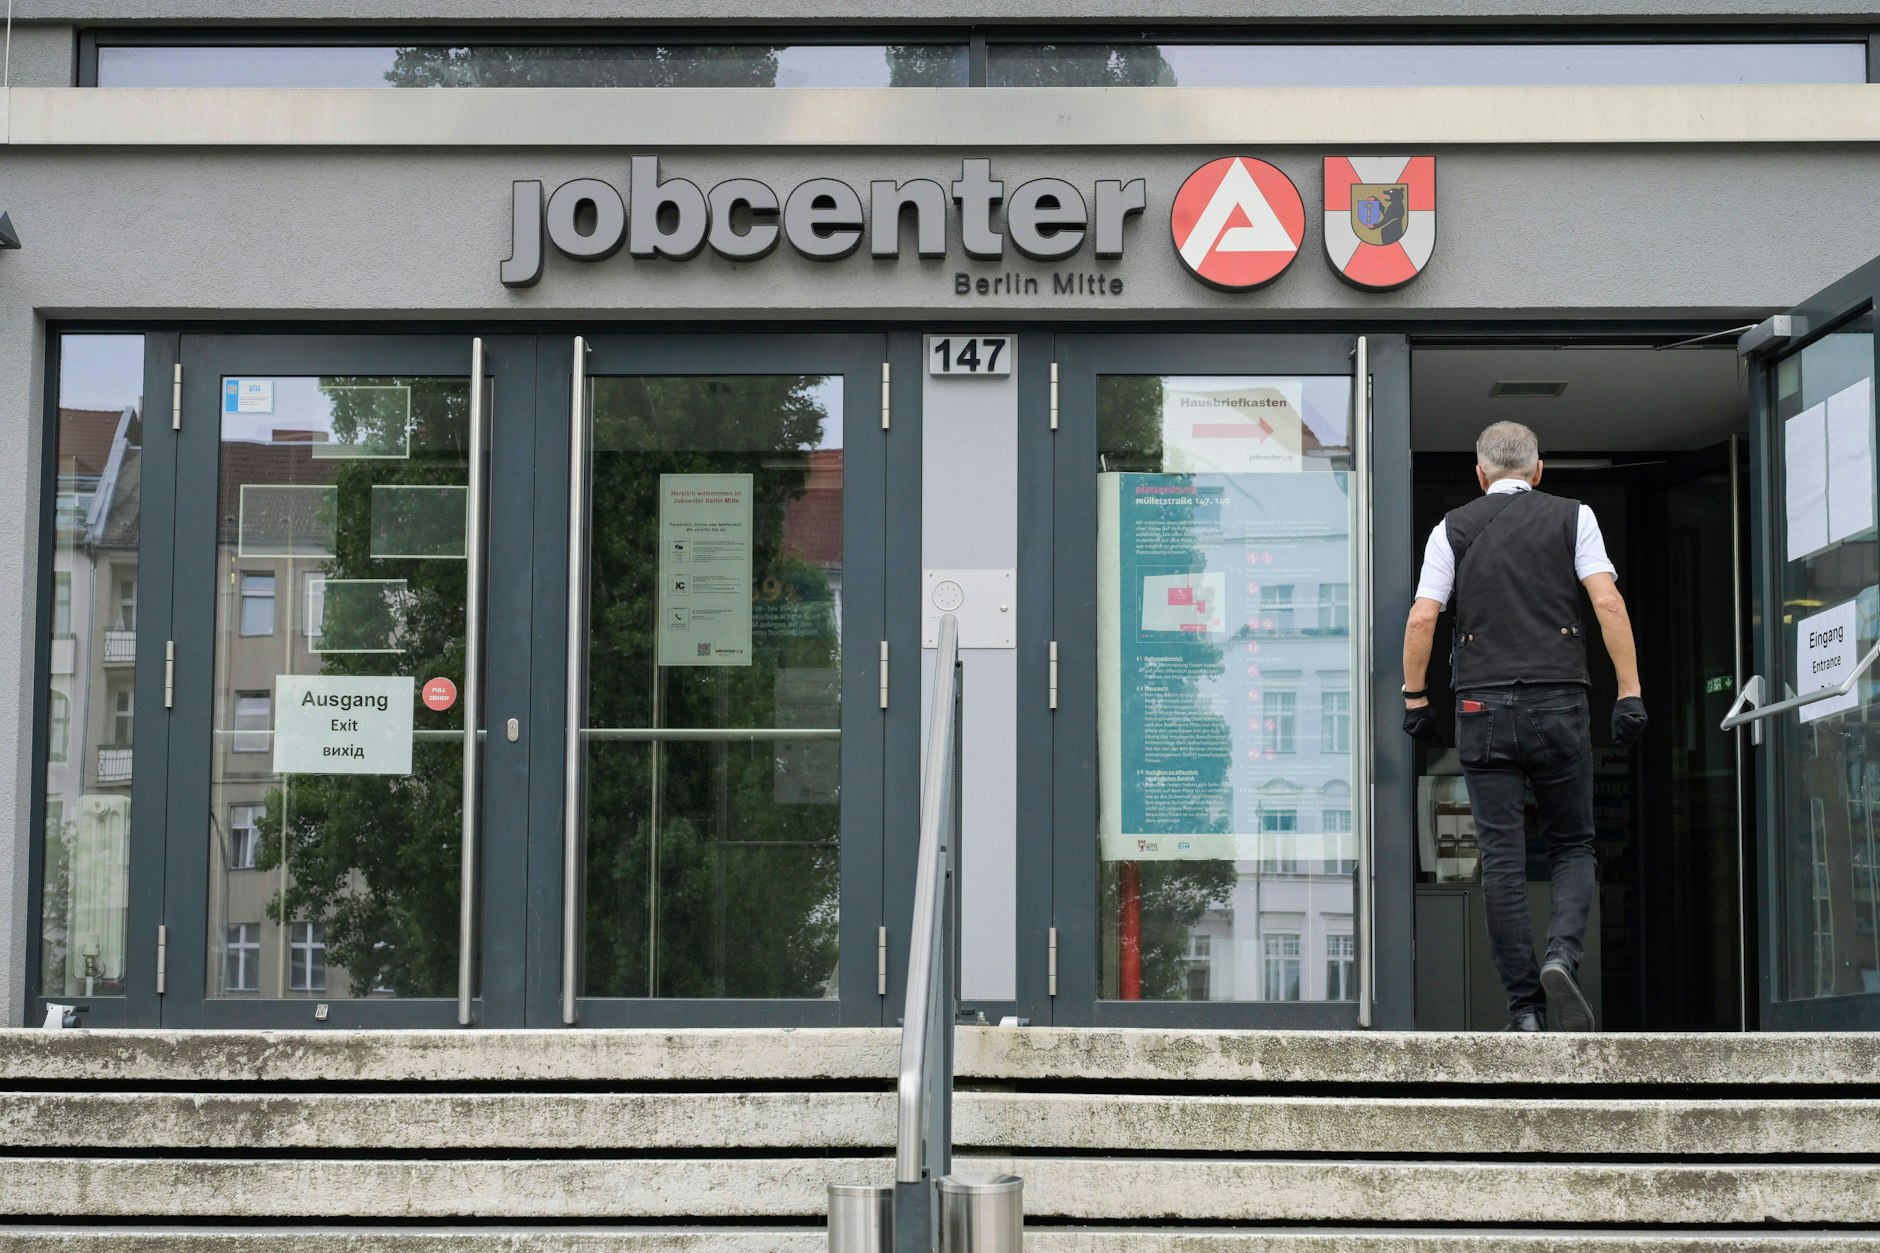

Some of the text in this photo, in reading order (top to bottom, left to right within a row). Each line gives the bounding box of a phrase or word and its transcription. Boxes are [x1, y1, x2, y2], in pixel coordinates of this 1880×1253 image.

[501, 155, 1146, 288] jobcenter
[955, 272, 1124, 296] Berlin Mitte
[933, 337, 1009, 374] 147
[1180, 398, 1288, 408] Hausbriefkasten
[1248, 454, 1282, 462] jobcenter
[1136, 497, 1192, 505] müllerstraße
[1214, 497, 1231, 505] 149
[1809, 626, 1844, 649] Eingang
[1813, 655, 1841, 674] Entrance
[301, 690, 388, 711] Ausgang
[331, 719, 358, 732] Exit
[323, 744, 364, 759] вихід
[1600, 753, 1629, 767] jobc
